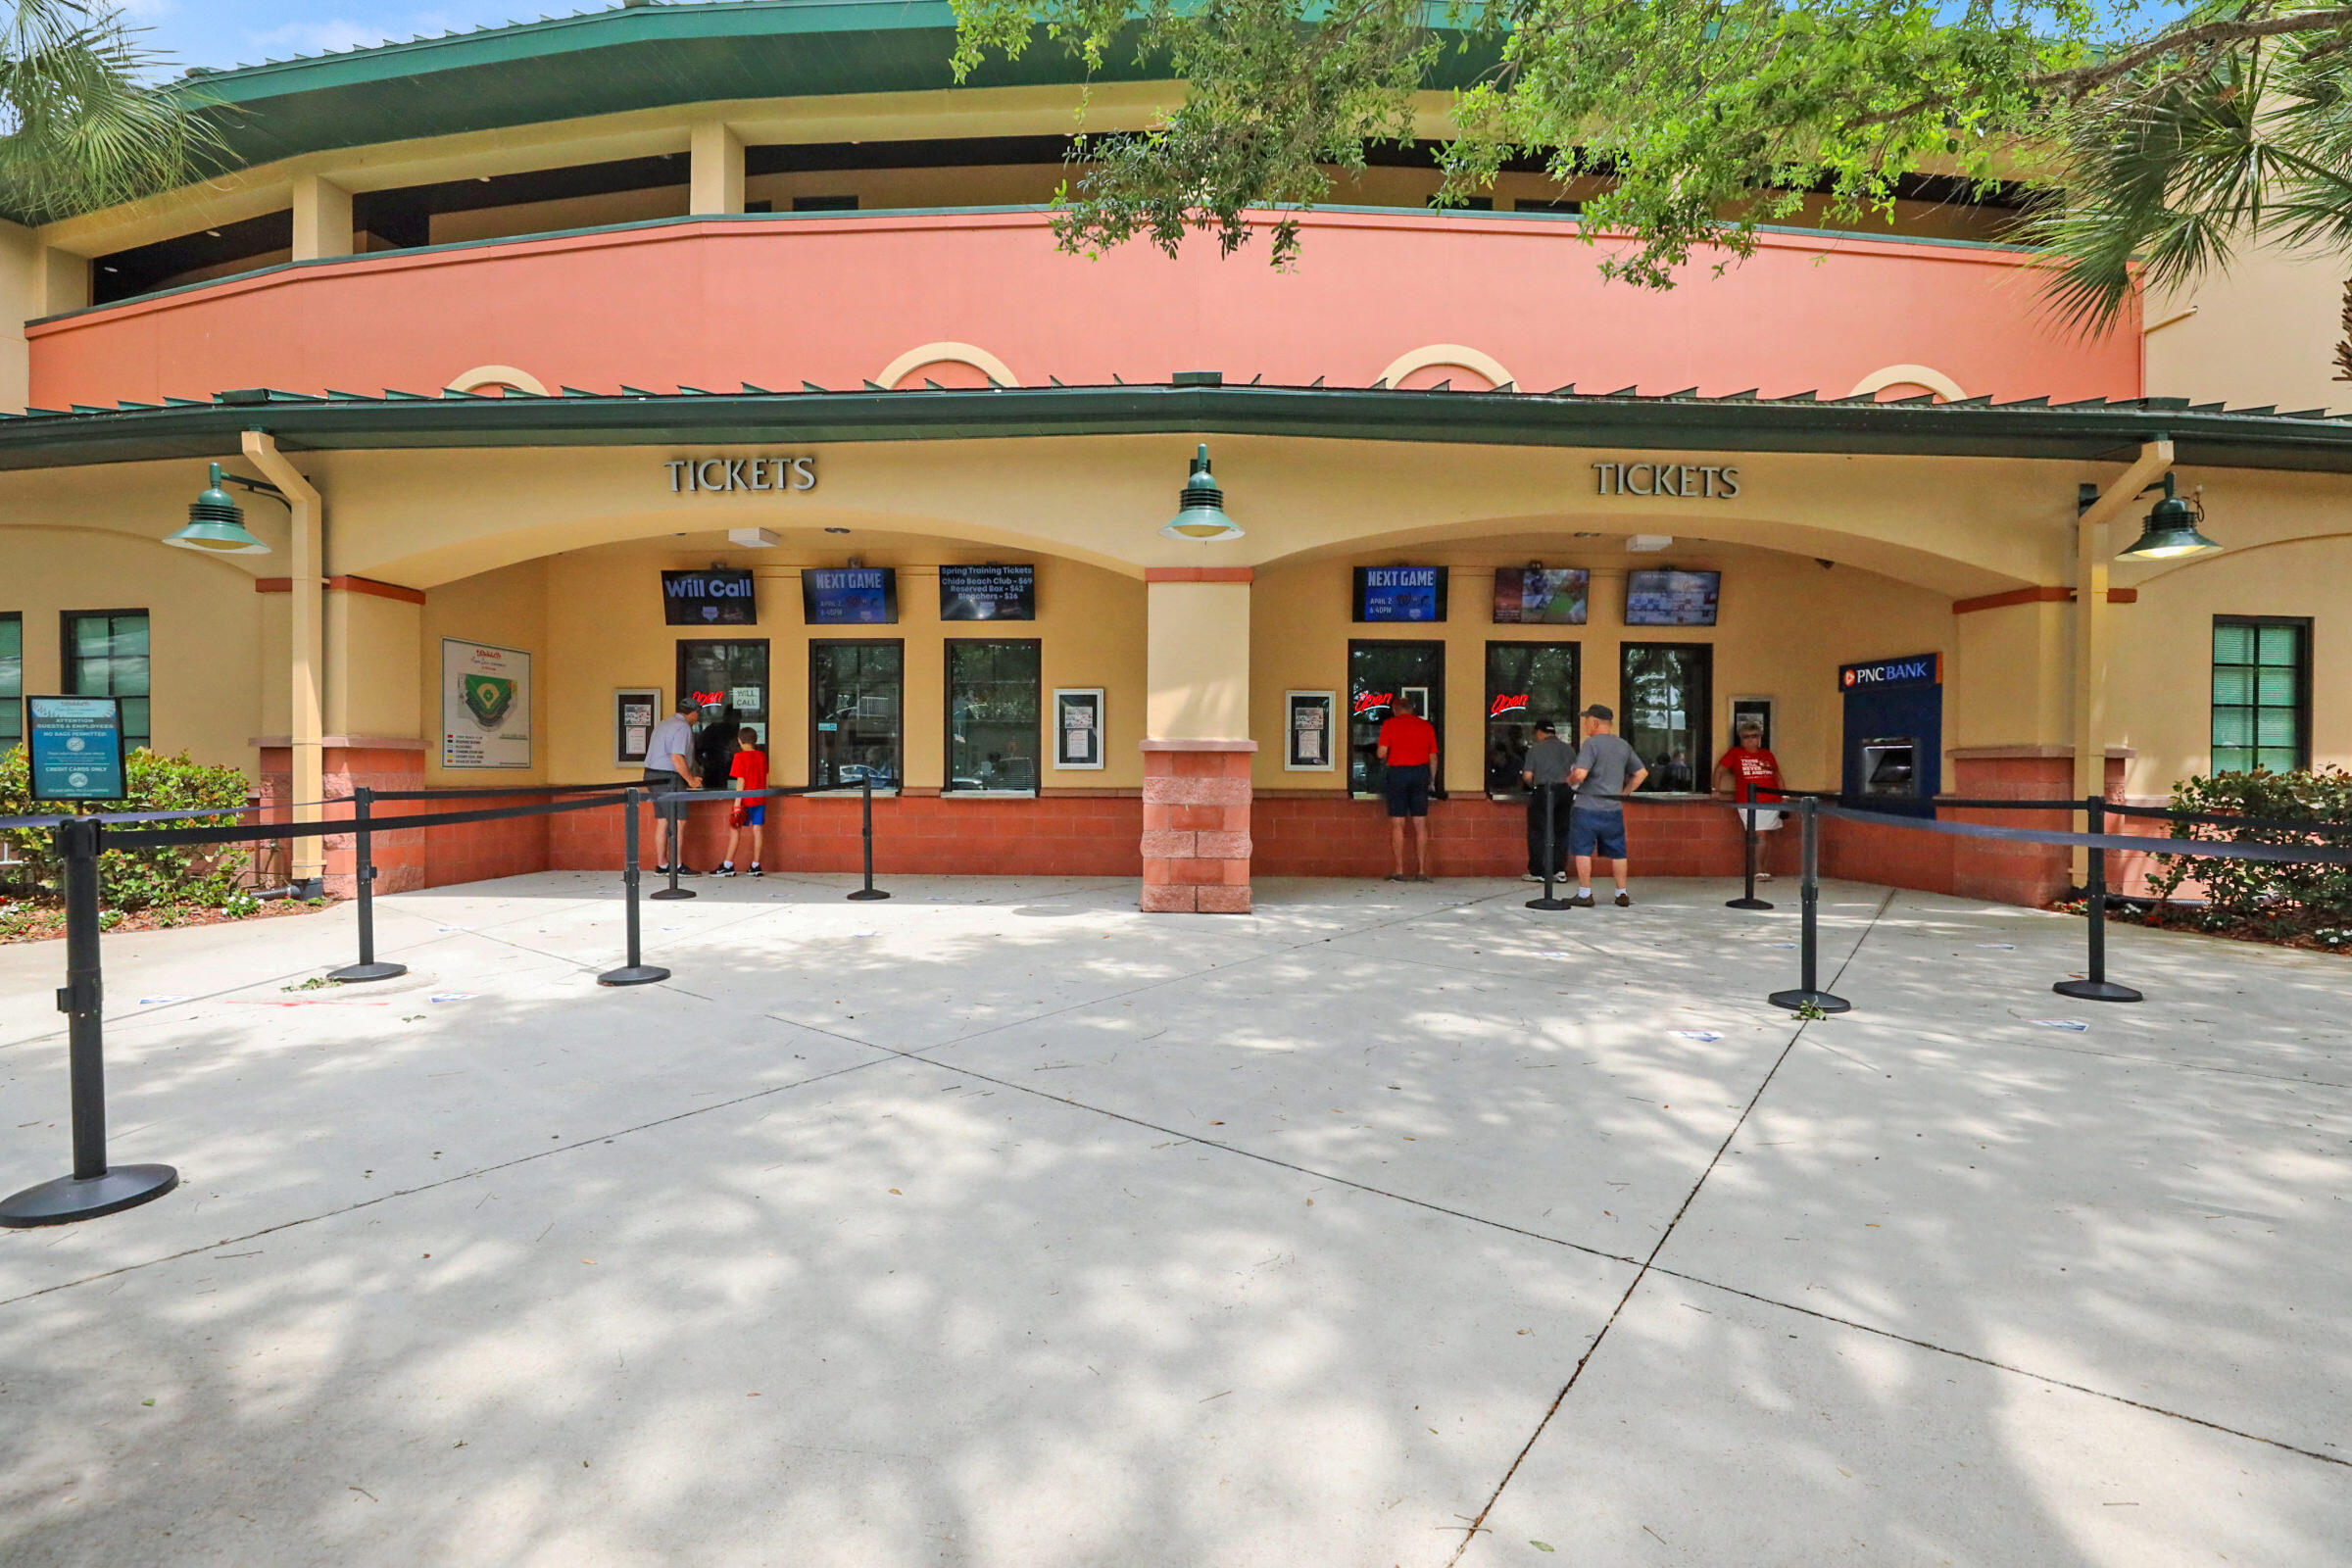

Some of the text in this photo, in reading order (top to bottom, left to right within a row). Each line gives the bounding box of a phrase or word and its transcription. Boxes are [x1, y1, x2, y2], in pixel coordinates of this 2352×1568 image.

[664, 458, 816, 492] TICKETS
[1592, 464, 1740, 498] TICKETS
[816, 572, 882, 589] NEXT GAME
[941, 566, 967, 575] Spring
[968, 566, 1002, 575] Training
[1368, 570, 1435, 587] NEXT GAME
[664, 579, 752, 598] Will Call
[1856, 662, 1928, 683] PNC BANK
[1354, 692, 1394, 713] Open
[1492, 694, 1529, 714] Open
